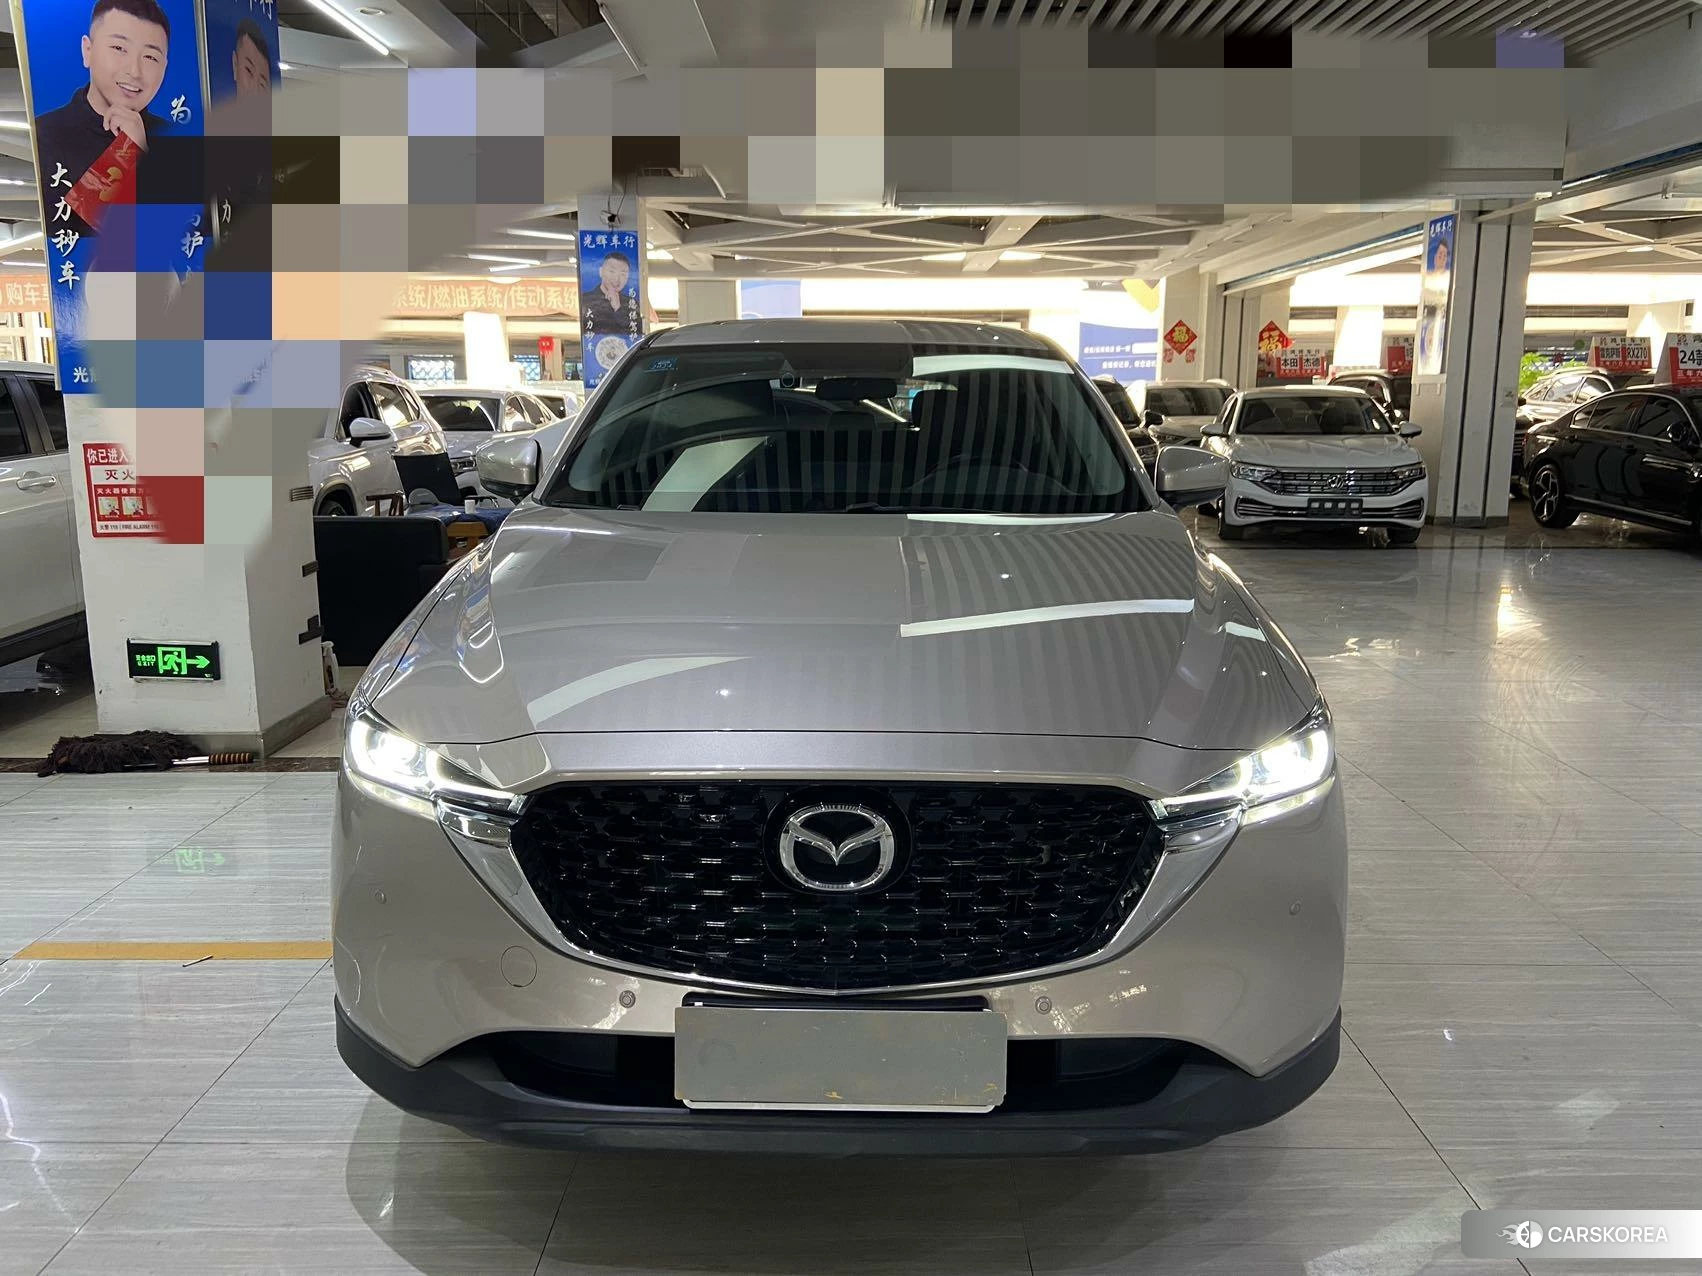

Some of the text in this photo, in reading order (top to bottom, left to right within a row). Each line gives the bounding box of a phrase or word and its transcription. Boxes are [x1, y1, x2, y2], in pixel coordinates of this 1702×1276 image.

[170, 94, 192, 124] 为
[50, 162, 81, 291] 大力秒车
[1627, 347, 1648, 359] RX270
[1282, 358, 1298, 368] 本田
[87, 449, 129, 464] 你已进入
[104, 469, 136, 481] 灭火
